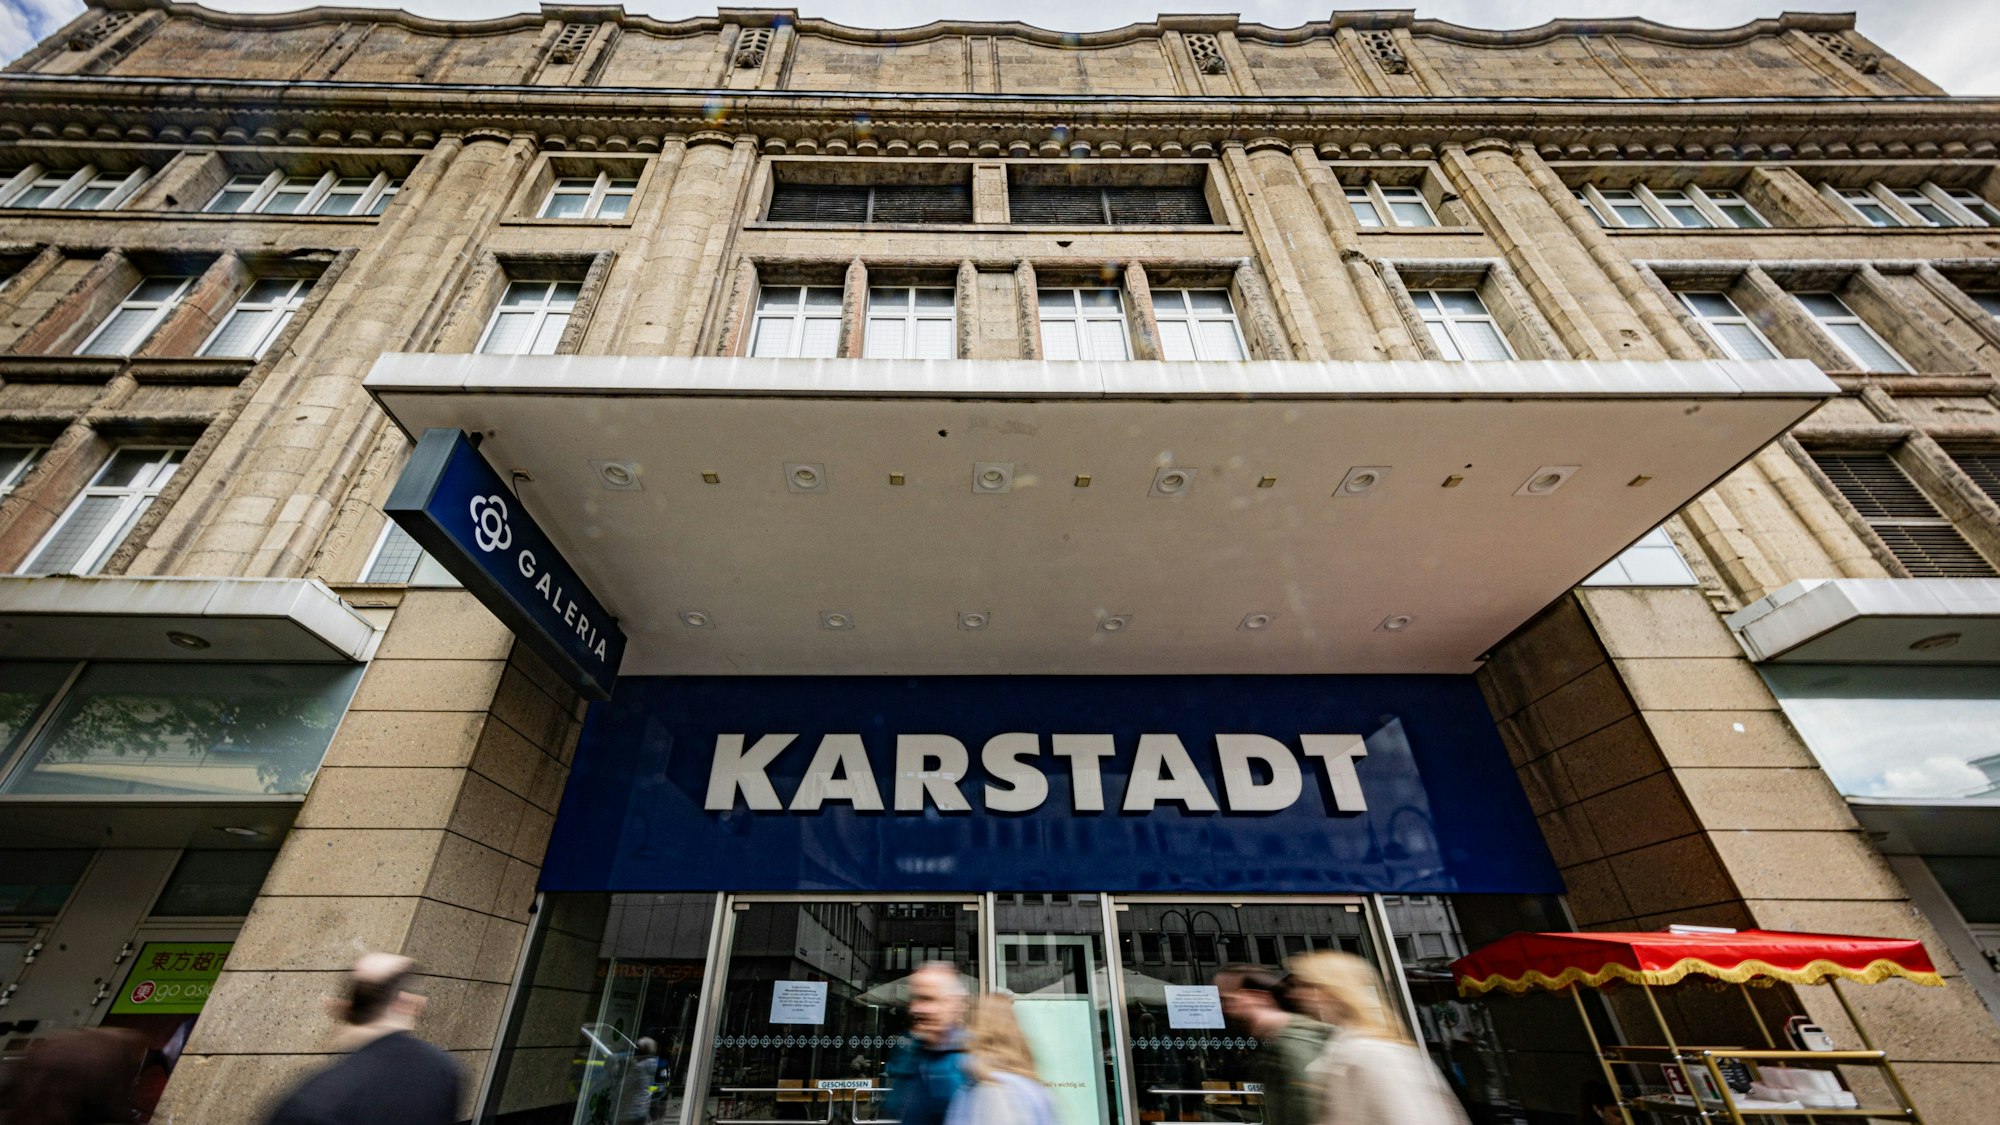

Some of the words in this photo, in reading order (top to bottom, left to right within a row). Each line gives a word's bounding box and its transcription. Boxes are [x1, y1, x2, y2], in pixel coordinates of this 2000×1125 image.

[518, 549, 606, 662] GALERIA
[704, 733, 1368, 812] KARSTADT
[155, 984, 181, 1002] go
[821, 1080, 869, 1089] GESCHLOSSEN
[1058, 1080, 1077, 1089] wichtig
